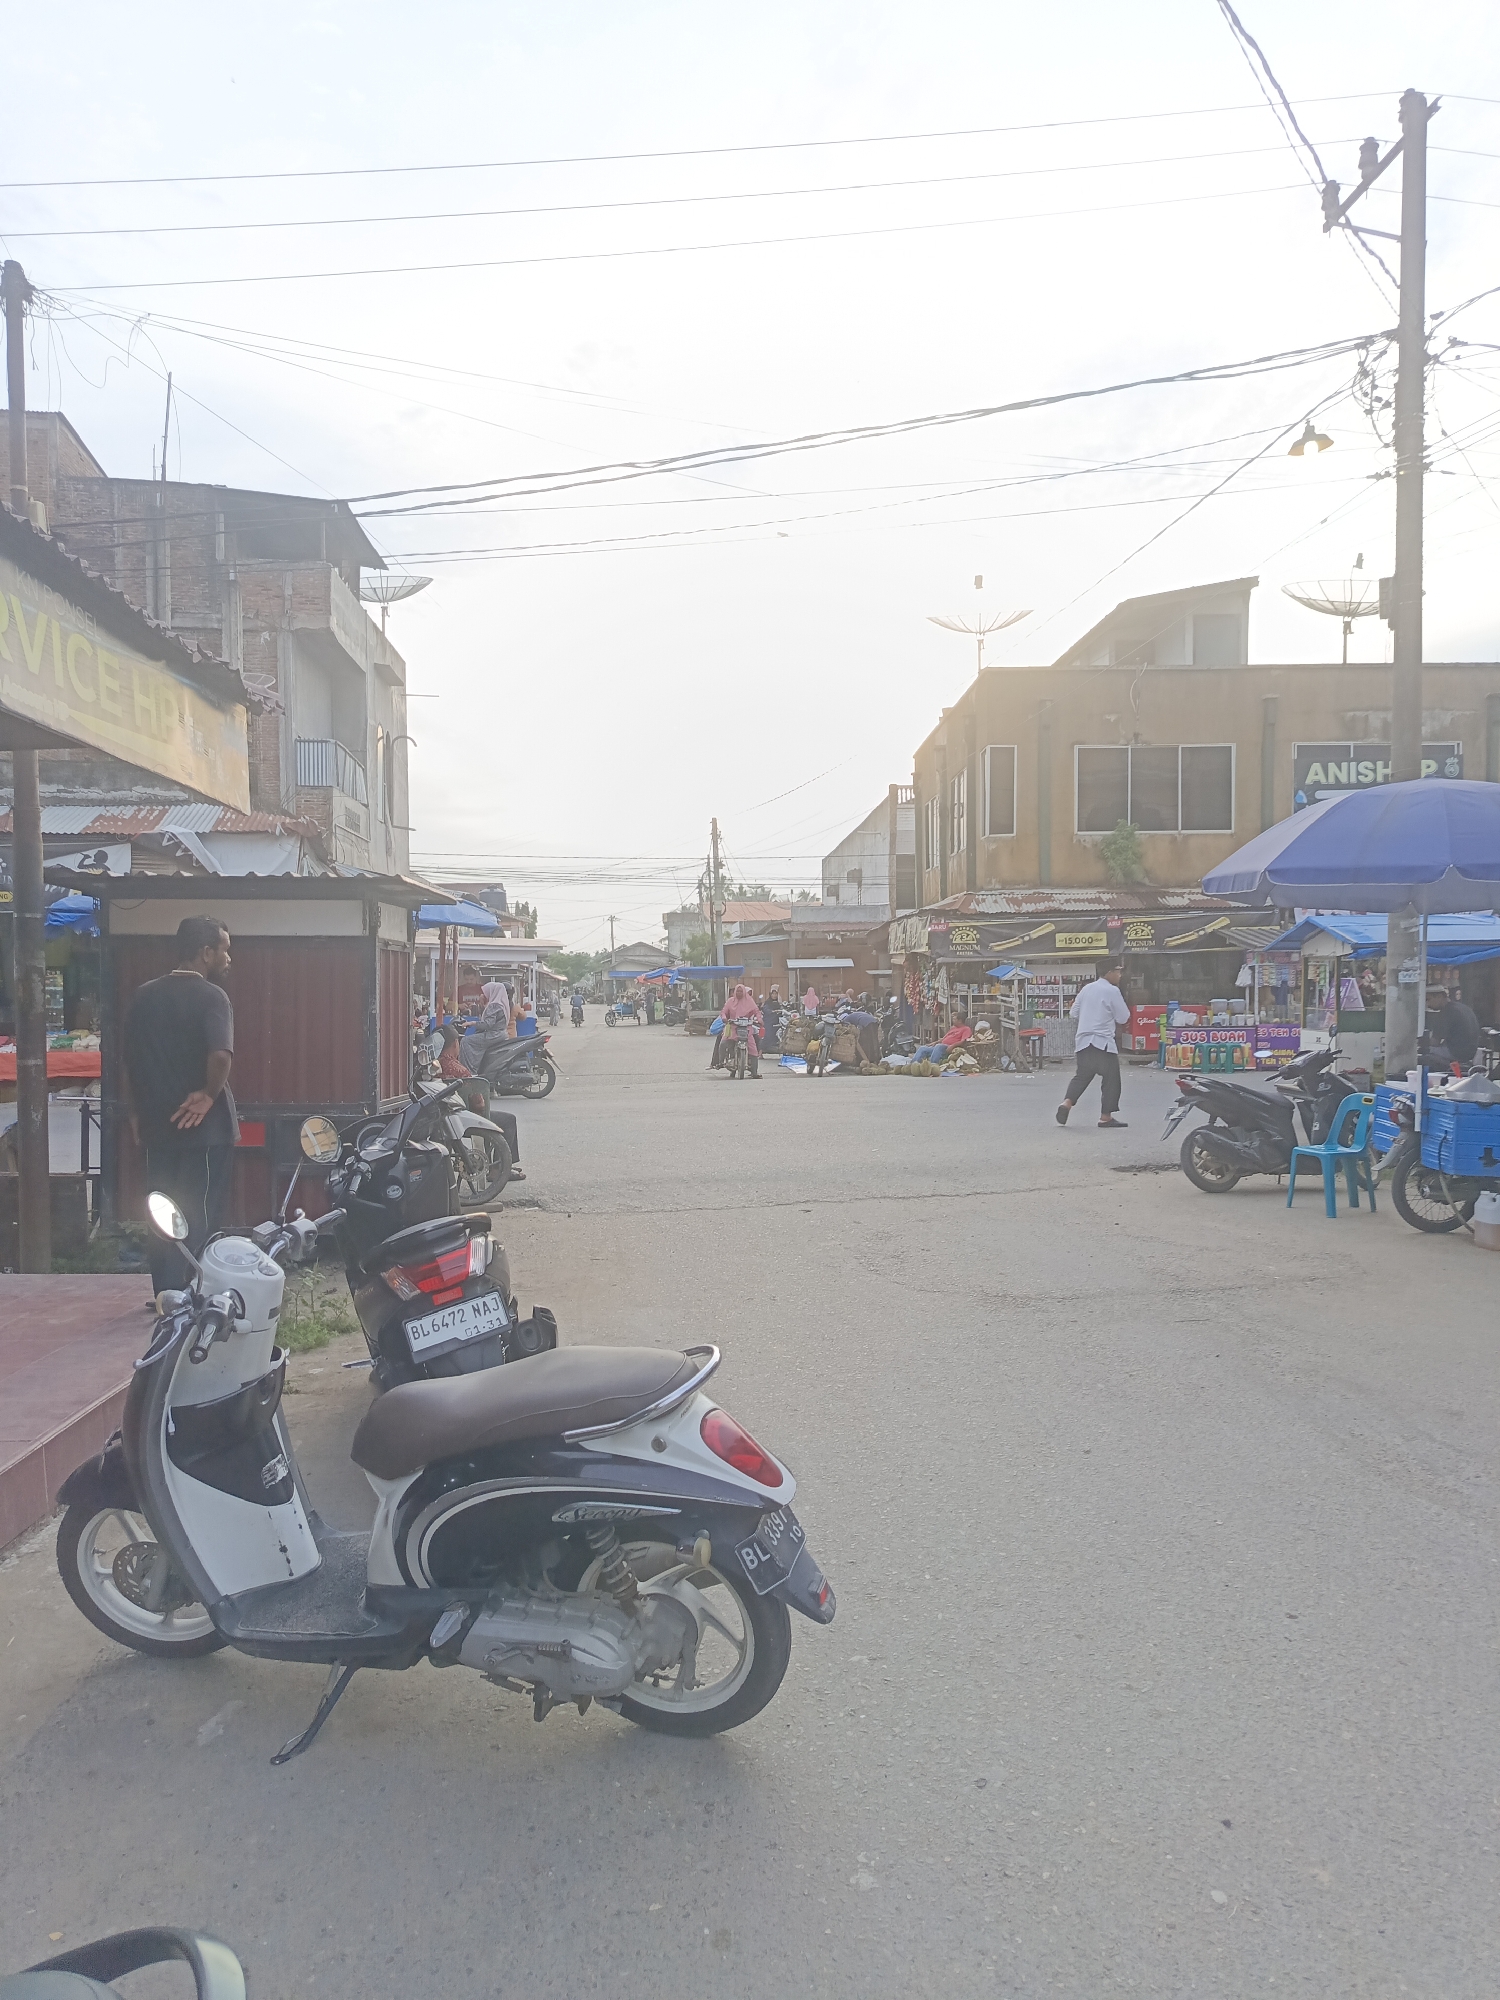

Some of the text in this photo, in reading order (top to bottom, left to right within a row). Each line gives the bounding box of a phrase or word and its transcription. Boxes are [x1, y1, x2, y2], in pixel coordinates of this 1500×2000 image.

[132, 666, 179, 742] HP
[1305, 759, 1439, 786] ANISHP
[1181, 1031, 1208, 1044] JUS
[1209, 1031, 1247, 1043] BUAH
[1269, 1027, 1290, 1038] TEH
[410, 1322, 431, 1341] BL
[431, 1307, 467, 1333] 6472
[471, 1296, 501, 1319] NAJ
[740, 1542, 771, 1570] BL
